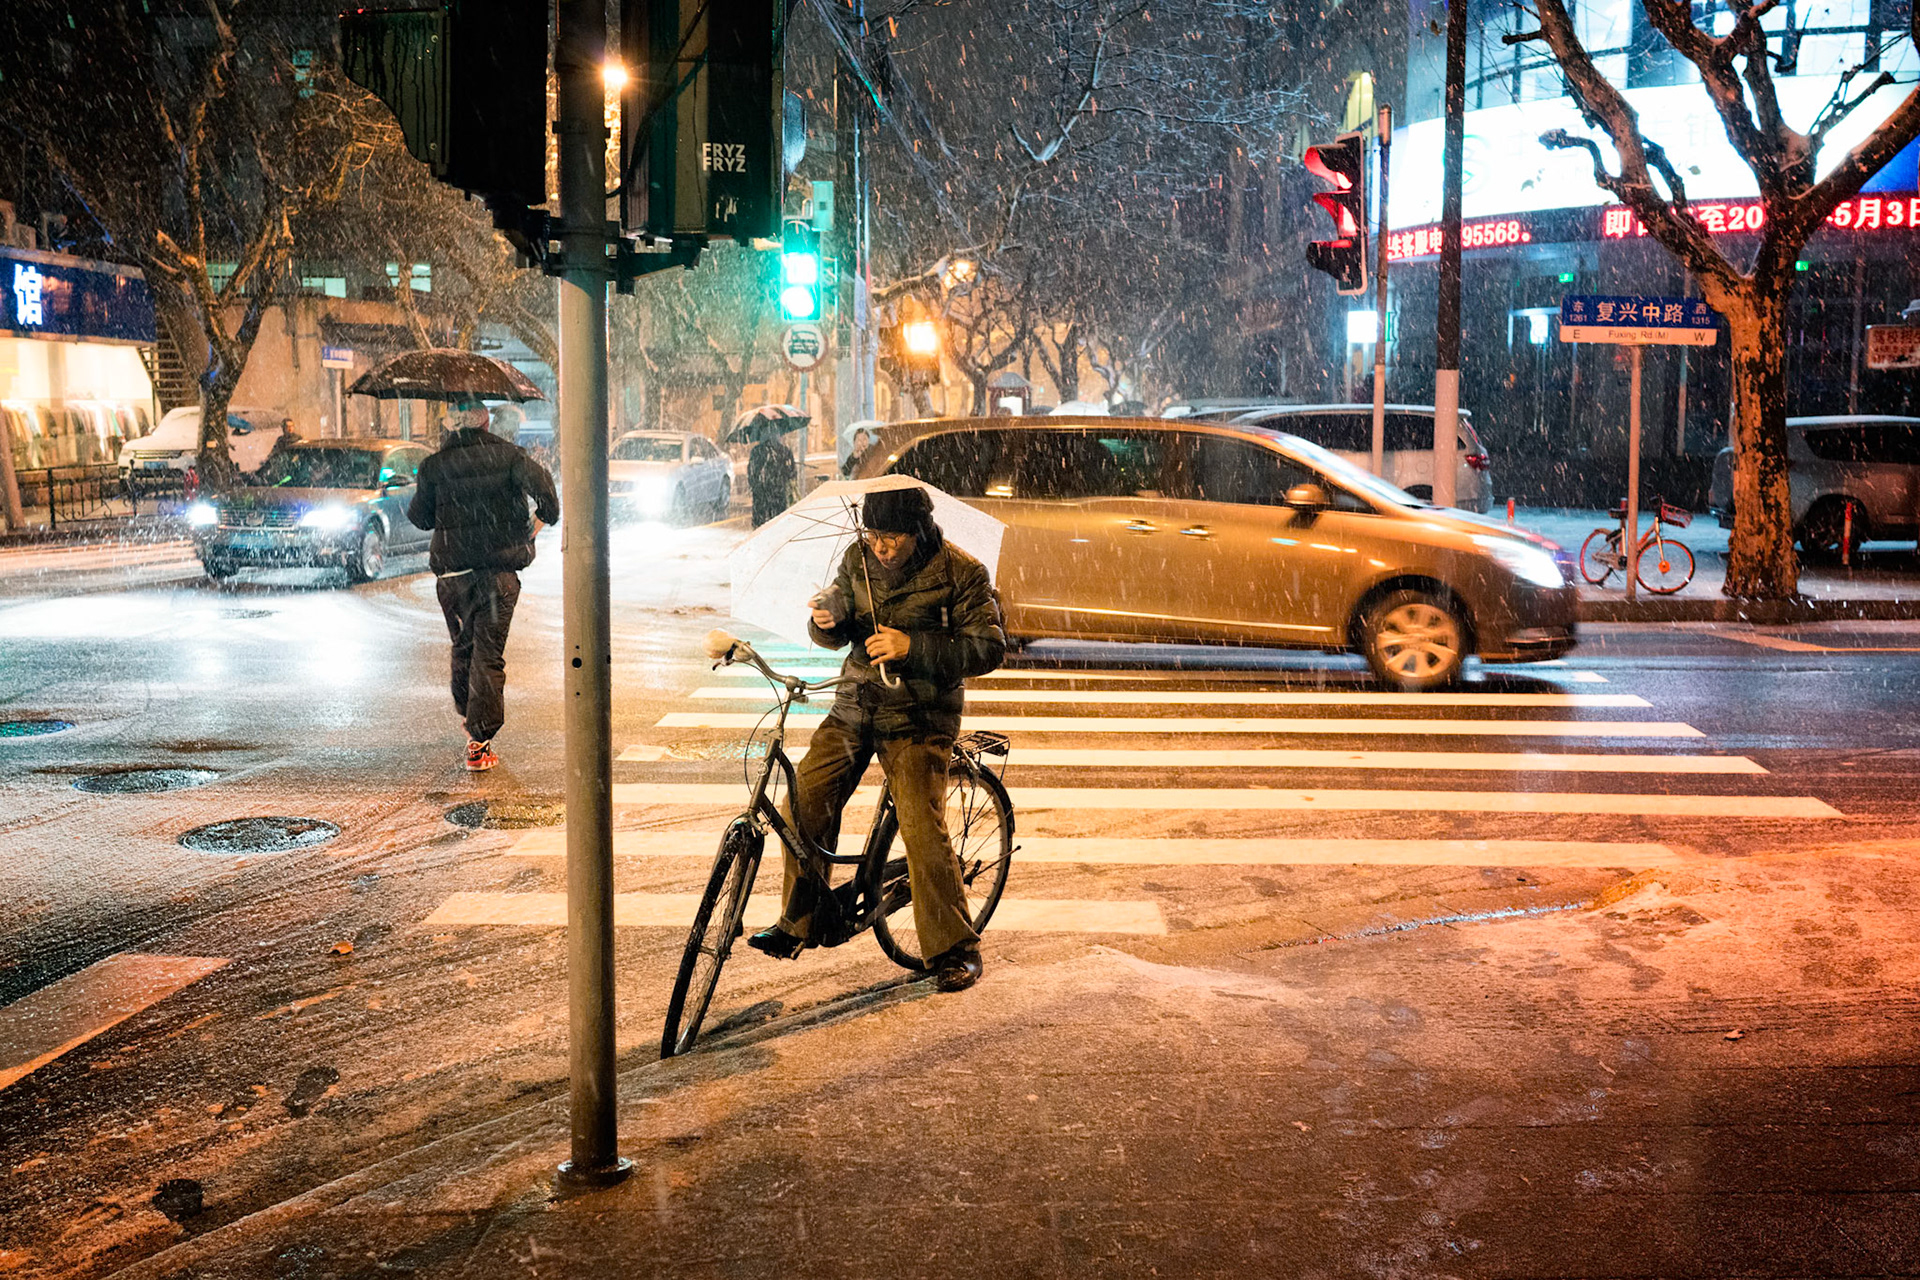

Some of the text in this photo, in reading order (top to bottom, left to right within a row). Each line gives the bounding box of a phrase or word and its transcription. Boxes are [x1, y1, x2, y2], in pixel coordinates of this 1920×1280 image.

[702, 143, 745, 158] FRYZ
[702, 157, 746, 172] FRYZ
[1572, 301, 1584, 312] 东
[1695, 303, 1706, 314] 西
[1596, 302, 1684, 323] 复兴中路
[1569, 314, 1587, 322] 1261
[1691, 316, 1710, 325] 1315
[1573, 329, 1581, 339] E
[1608, 330, 1637, 340] Fuxing
[1694, 332, 1706, 341] W
